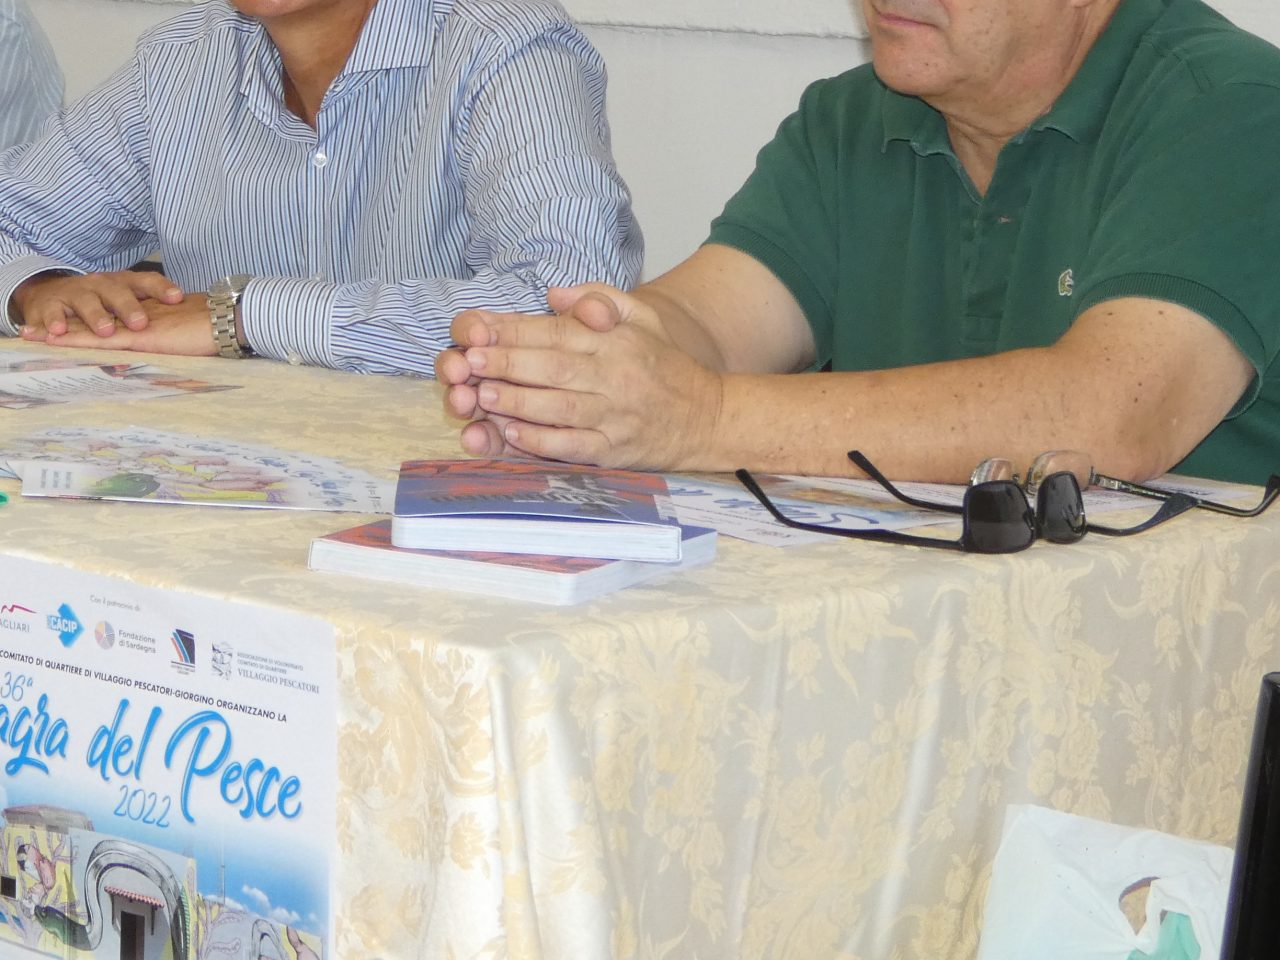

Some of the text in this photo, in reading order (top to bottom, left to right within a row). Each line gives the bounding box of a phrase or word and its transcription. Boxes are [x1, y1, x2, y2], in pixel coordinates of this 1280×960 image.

[47, 614, 78, 634] CACIP
[118, 629, 156, 644] Fondazione
[118, 639, 156, 653] di Sardegna
[36, 657, 43, 667] DI
[44, 659, 83, 676] QUARTIERE
[84, 668, 92, 677] DI
[94, 671, 132, 688] VILLAGGIO
[134, 680, 215, 706] PESCATORI-GIORGINO
[216, 699, 275, 720] ORGANIZZANO
[277, 713, 287, 723] LA
[238, 668, 320, 694] VILLAGGIO PESCATORI
[86, 697, 162, 782] del
[164, 710, 302, 824] Pesce
[114, 784, 172, 829] 2022
